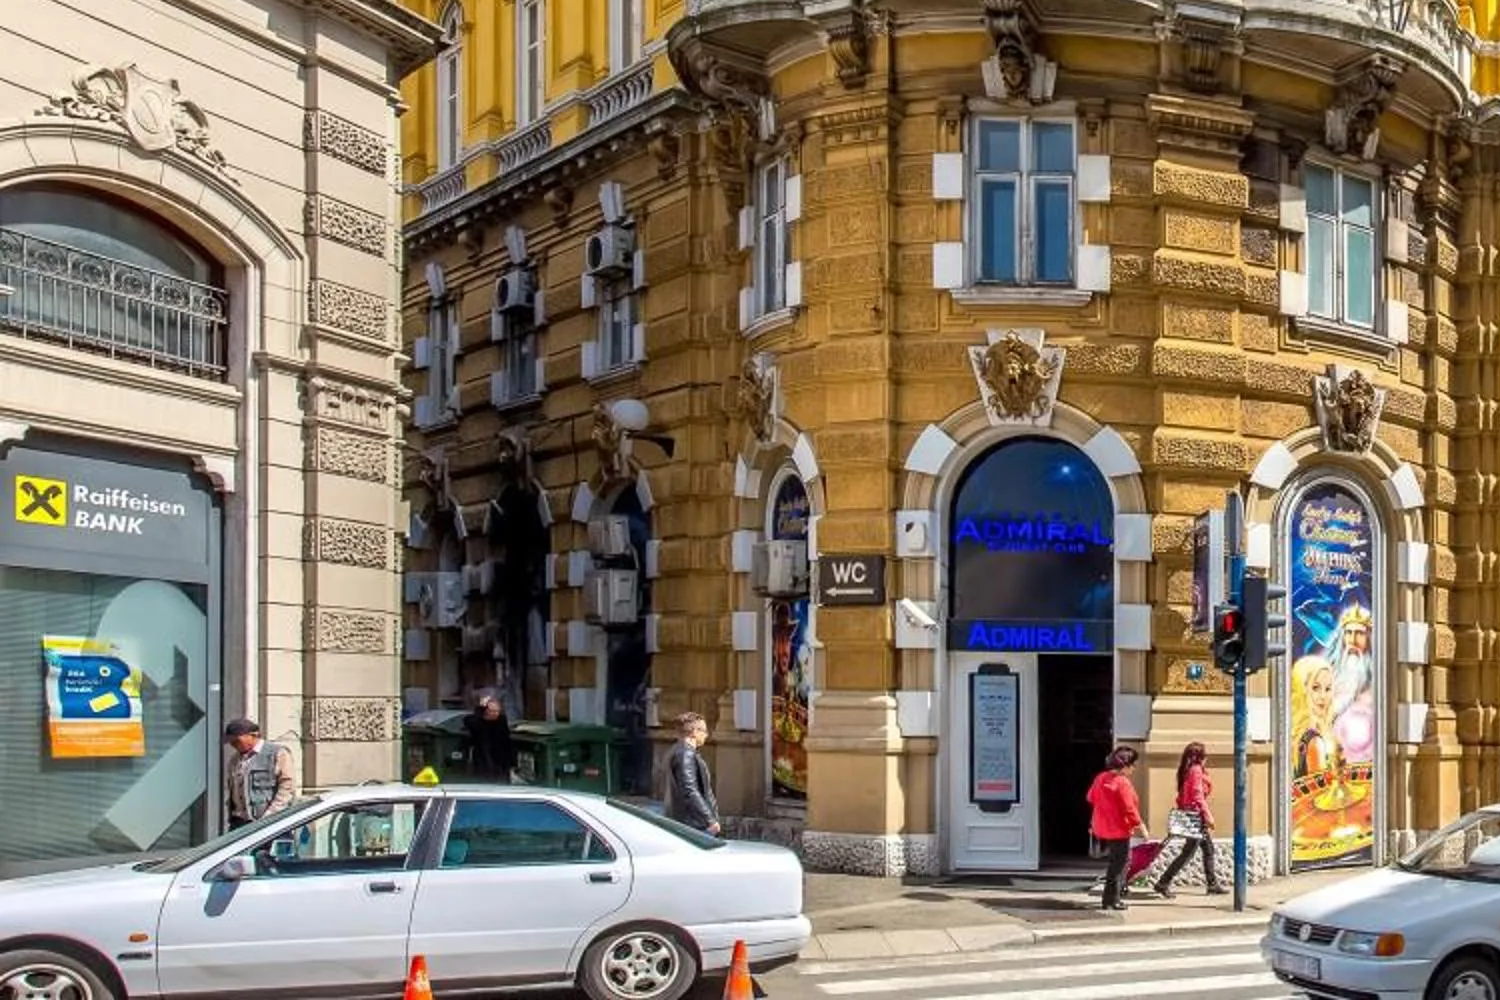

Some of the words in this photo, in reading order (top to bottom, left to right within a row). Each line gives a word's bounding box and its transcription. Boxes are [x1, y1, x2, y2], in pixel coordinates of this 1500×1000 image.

[73, 484, 186, 517] Raiffeisen
[75, 510, 145, 536] BANK
[954, 516, 1114, 545] ADMIRAL
[832, 562, 867, 584] WC
[968, 620, 1093, 651] ADMIRAL
